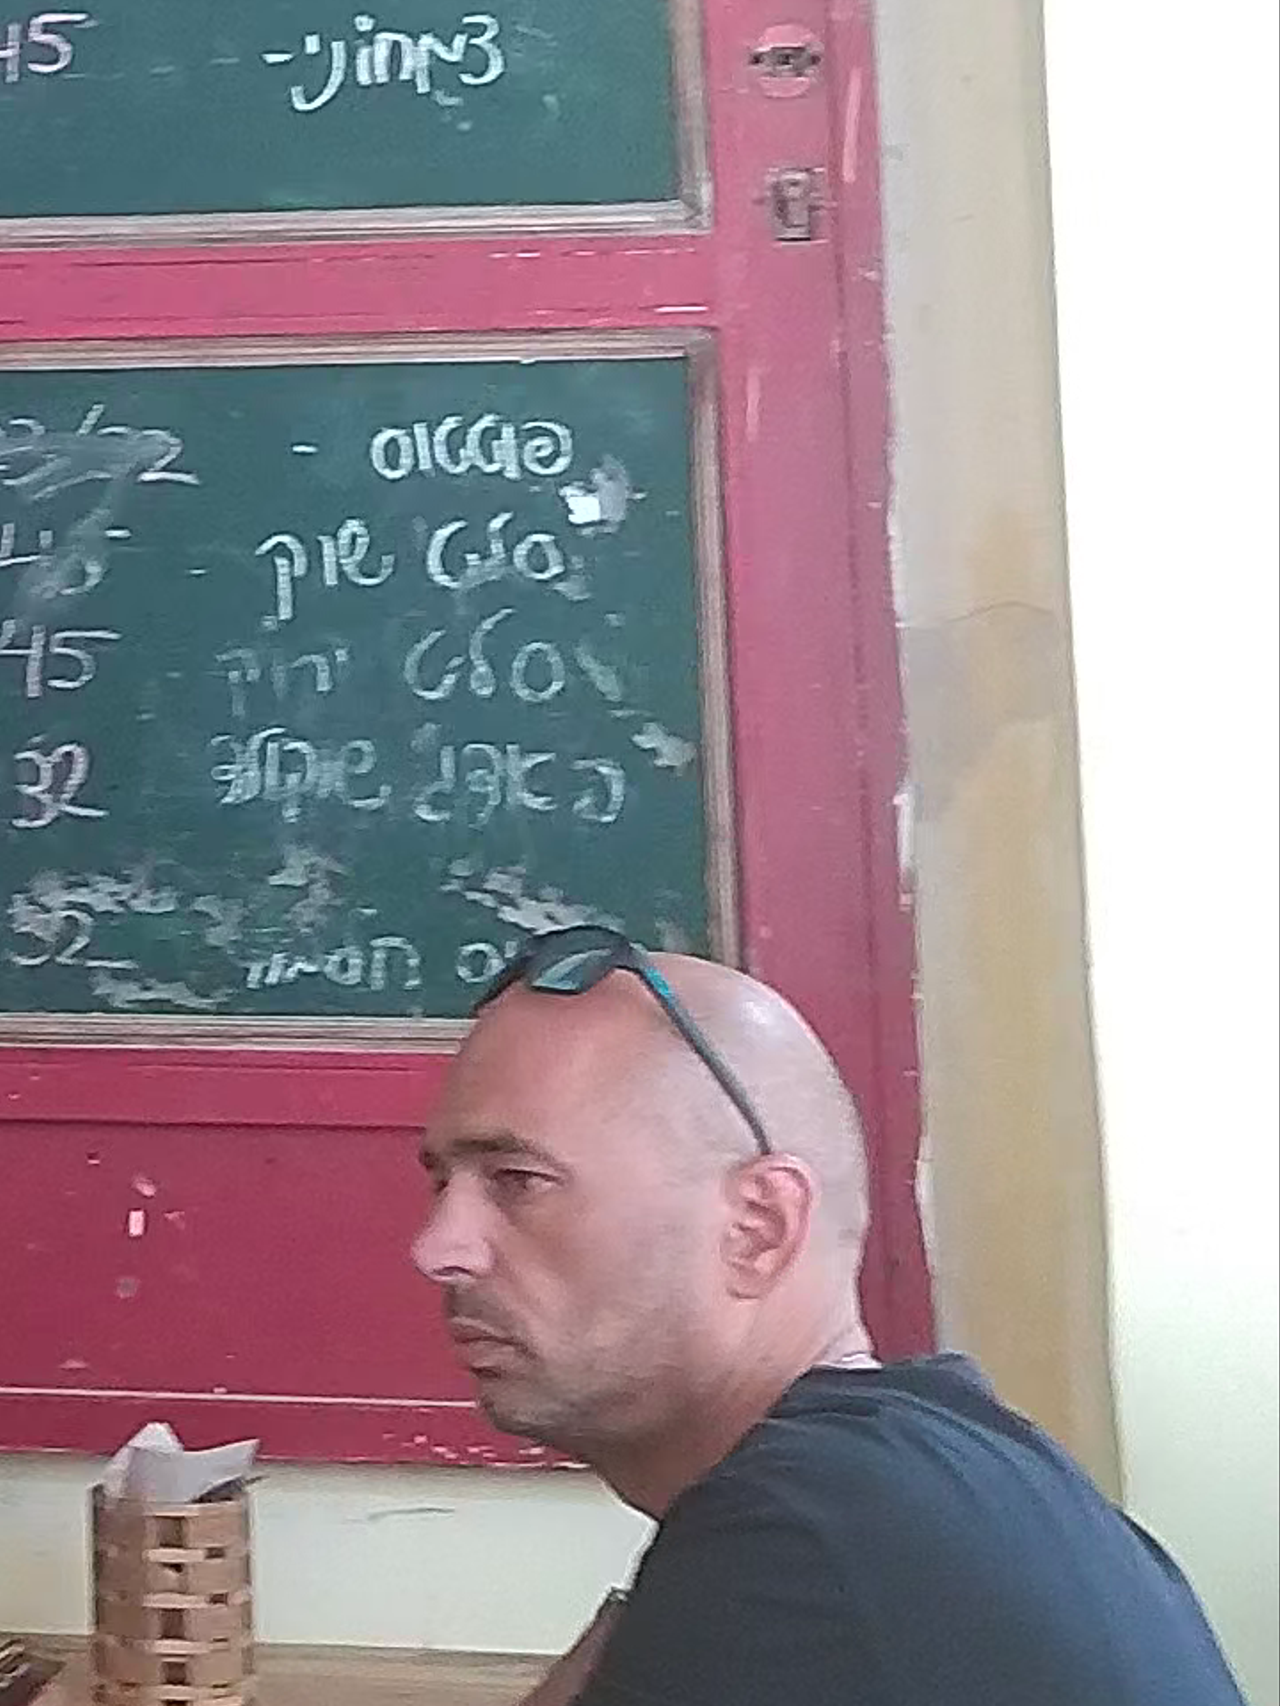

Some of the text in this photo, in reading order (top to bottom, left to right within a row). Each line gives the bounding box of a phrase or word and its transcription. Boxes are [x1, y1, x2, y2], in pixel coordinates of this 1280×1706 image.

[254, 511, 567, 626] סלט שוק
[403, 607, 568, 701] סלט
